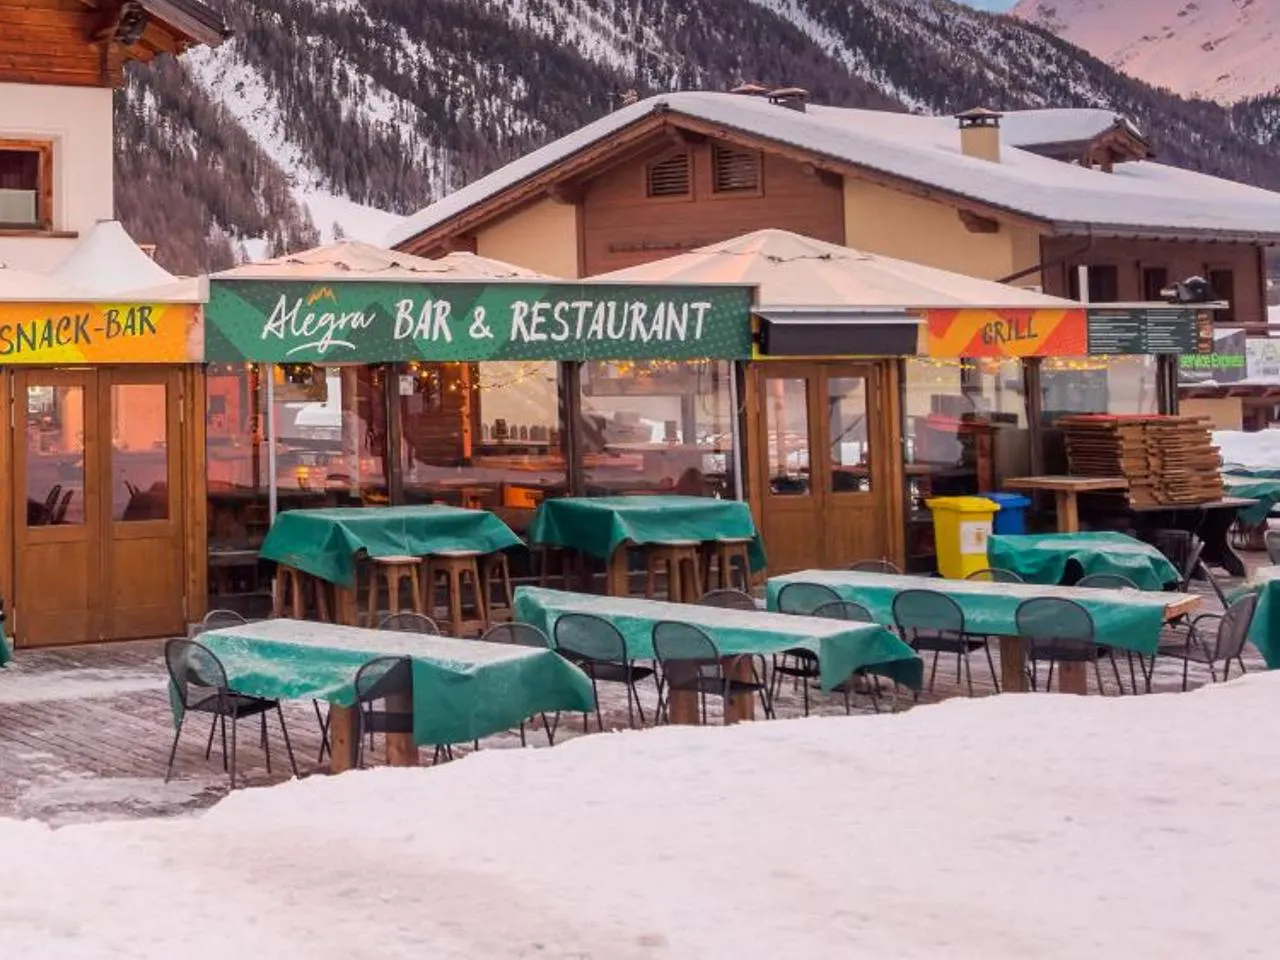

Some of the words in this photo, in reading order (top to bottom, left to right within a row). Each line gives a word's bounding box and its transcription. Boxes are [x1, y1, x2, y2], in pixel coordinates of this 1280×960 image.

[262, 294, 376, 354] Alegra
[394, 299, 453, 343] BAR
[469, 306, 494, 339] &
[510, 300, 712, 344] RESTAURANT
[982, 316, 1039, 345] GRILL
